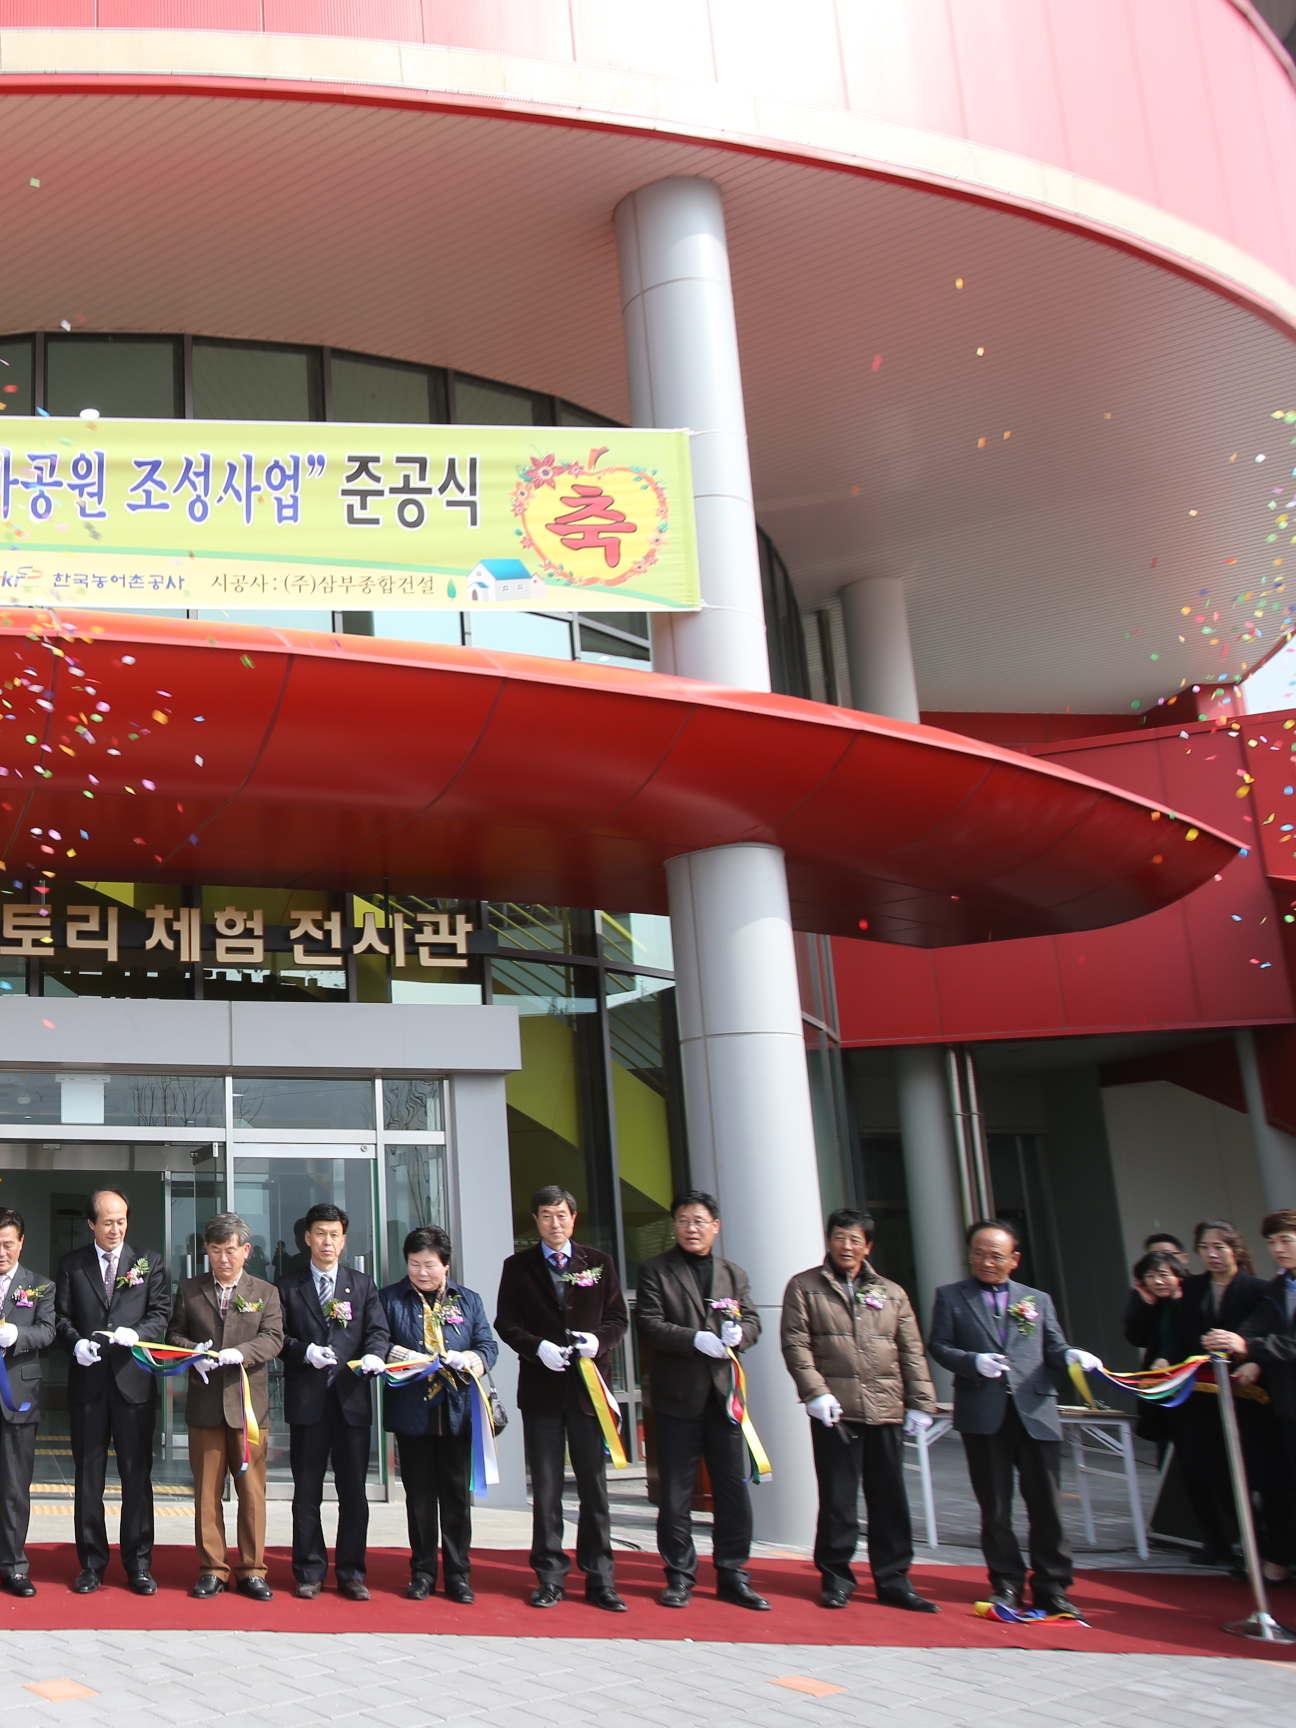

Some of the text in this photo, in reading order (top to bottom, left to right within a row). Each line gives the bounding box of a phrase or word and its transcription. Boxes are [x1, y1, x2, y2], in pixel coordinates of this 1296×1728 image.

[340, 455, 479, 528] 준공식
[545, 484, 637, 568] 축
[53, 572, 186, 591] 한국농어촌공사
[145, 904, 265, 964] 체험
[289, 909, 474, 968] 전시관
